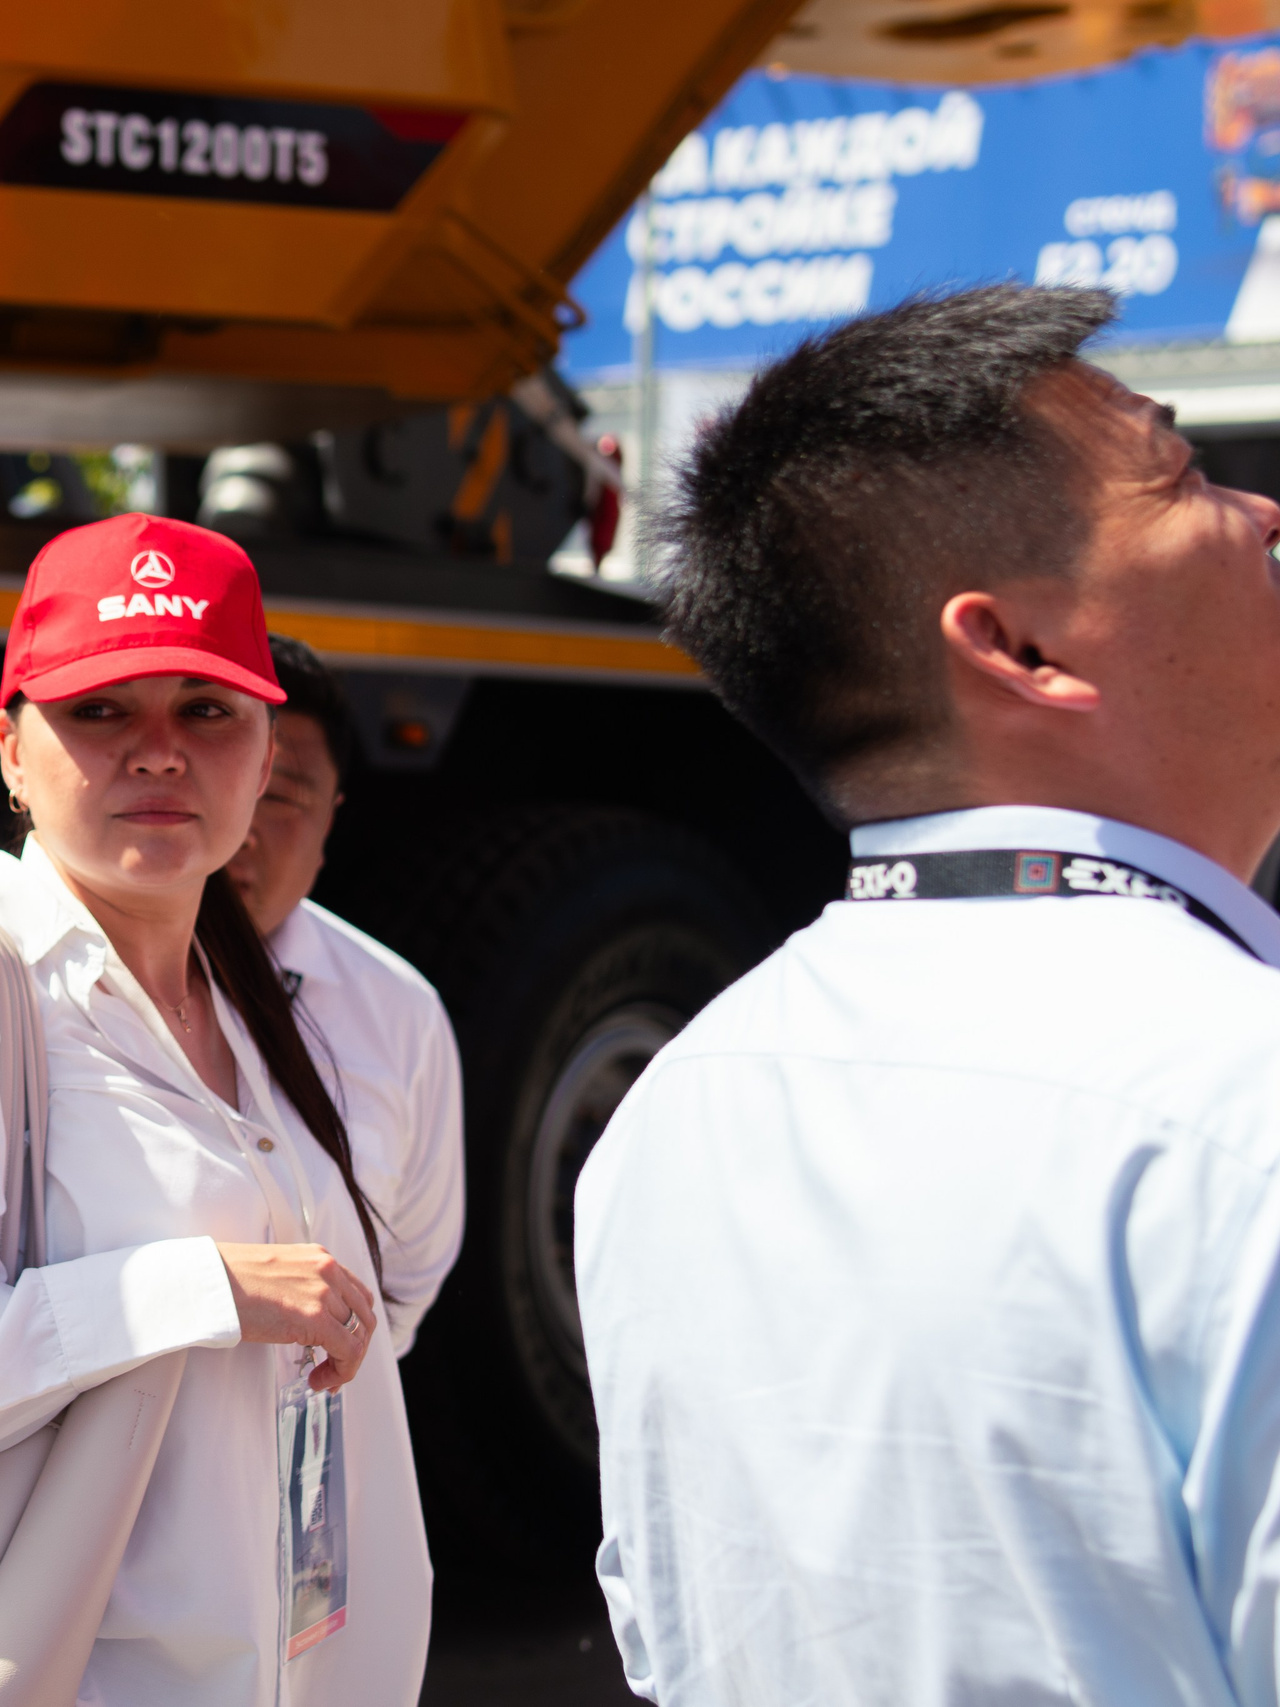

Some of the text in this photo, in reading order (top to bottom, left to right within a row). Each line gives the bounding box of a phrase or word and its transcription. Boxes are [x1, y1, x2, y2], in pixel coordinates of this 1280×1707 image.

[61, 107, 328, 186] STC1200T5
[650, 91, 982, 196] А КАЖДОЙ
[626, 179, 897, 263] СТРОЙКЕ
[97, 593, 209, 622] SANY
